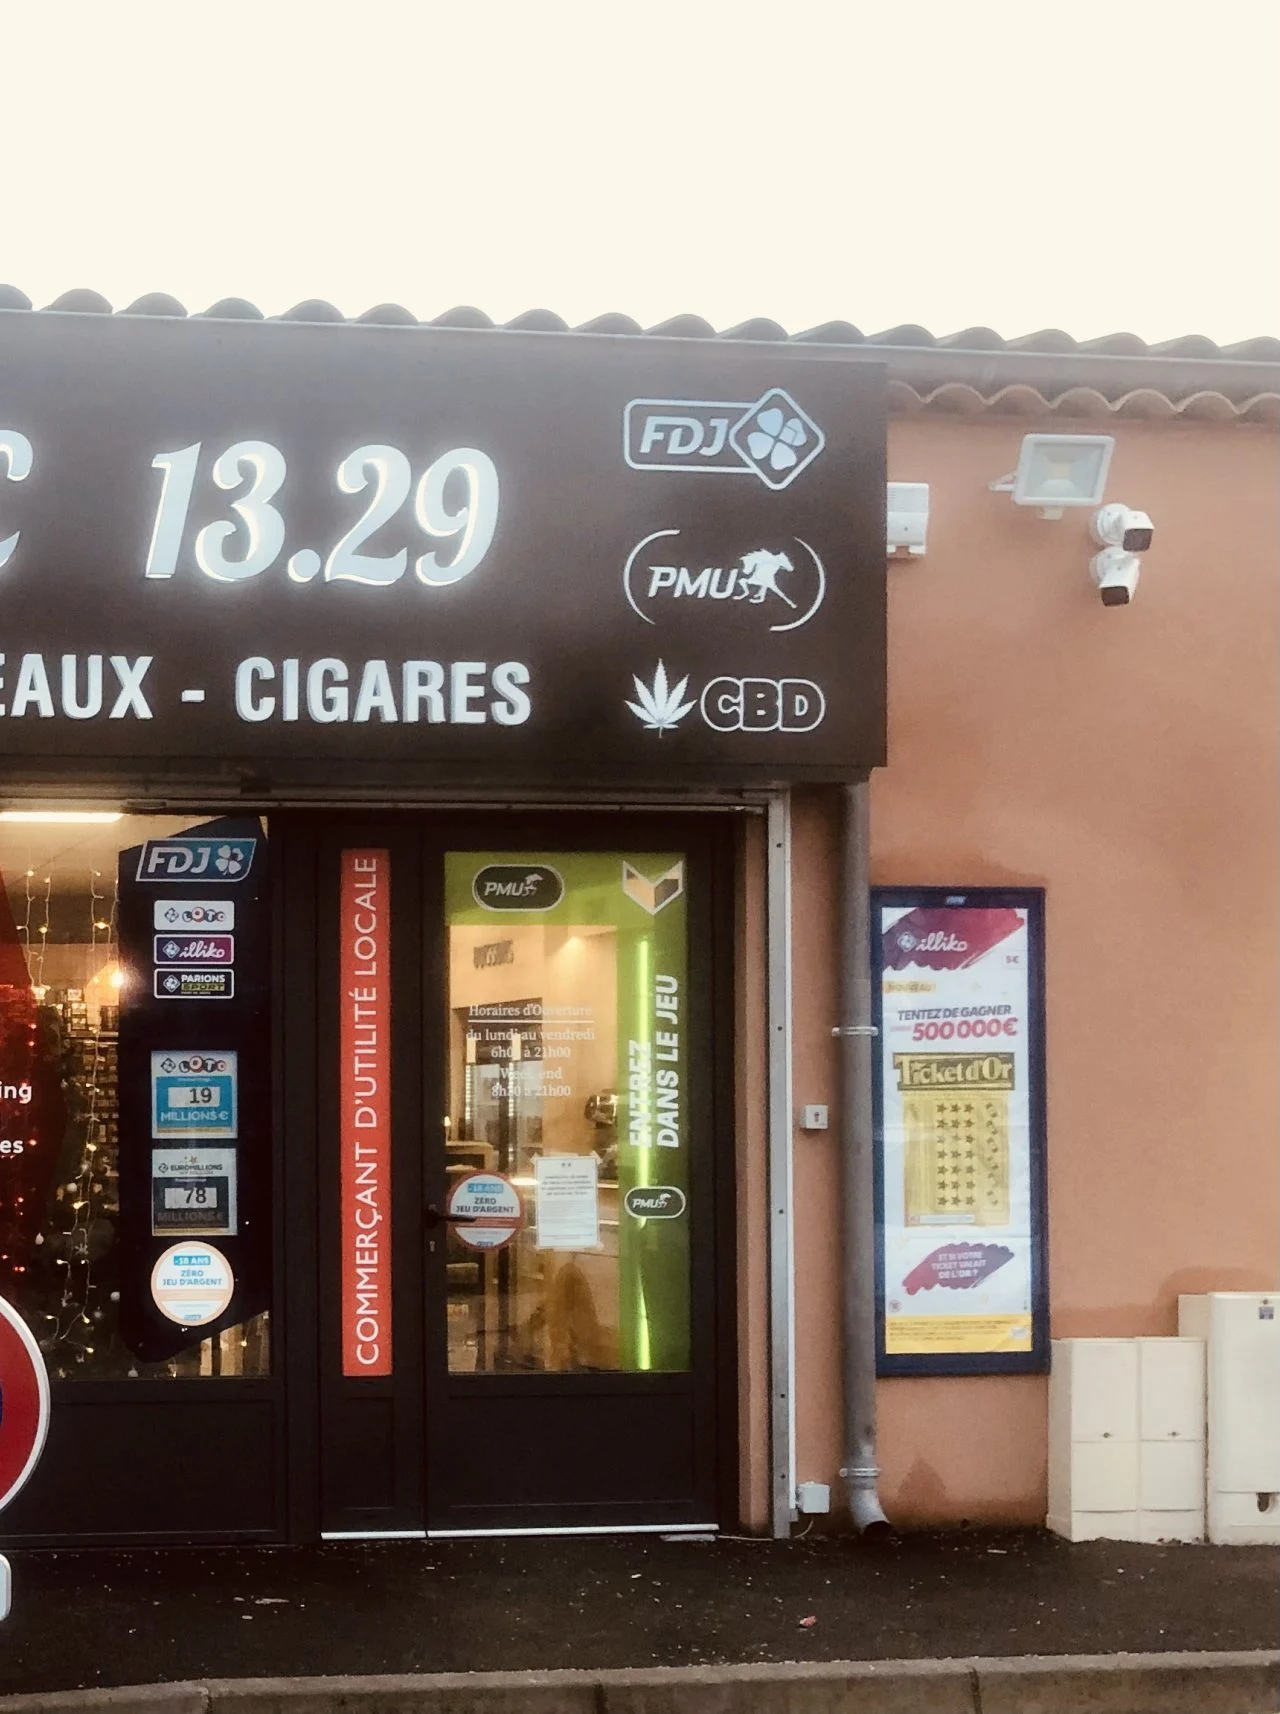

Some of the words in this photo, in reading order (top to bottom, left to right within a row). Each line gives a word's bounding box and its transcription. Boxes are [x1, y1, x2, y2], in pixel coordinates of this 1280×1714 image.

[639, 415, 730, 457] FDJ
[145, 440, 501, 588] 13.29
[648, 565, 738, 600] PMU
[234, 656, 533, 727] CIGARES
[700, 676, 826, 732] CBD
[147, 846, 212, 874] FDJ
[483, 881, 523, 896] PMU
[181, 906, 227, 923] LOTO
[353, 857, 378, 976] LOCALE
[178, 939, 226, 959] illiko
[915, 930, 968, 952] illiko
[181, 974, 226, 983] PARIONS
[182, 983, 225, 991] SPORT
[468, 1003, 520, 1016] Horaires
[655, 974, 679, 1026] JEU
[897, 1008, 942, 1021] TENTEZ
[943, 1007, 959, 1018] DE
[960, 1004, 1012, 1018] GAGNER
[466, 1029, 481, 1041] du
[522, 1031, 537, 1041] au
[540, 1029, 595, 1041] vendredi
[491, 1045, 520, 1058] 6h0
[656, 1030, 679, 1063] LE
[178, 1055, 228, 1073] LOTO
[349, 992, 378, 1129] D'UTILITÉ
[189, 1087, 213, 1104] 19
[629, 1039, 652, 1148] ENTREZ
[160, 1111, 218, 1121] MILLIONS
[656, 1068, 680, 1148] DANS
[183, 1187, 207, 1205] 78
[632, 1198, 658, 1209] PMU
[456, 1205, 471, 1213] JEU
[473, 1205, 515, 1213] D'ARGENT
[354, 1142, 382, 1366] COMMERÇANT
[163, 1278, 178, 1286] JEU
[180, 1278, 223, 1286] D'ARGENT
